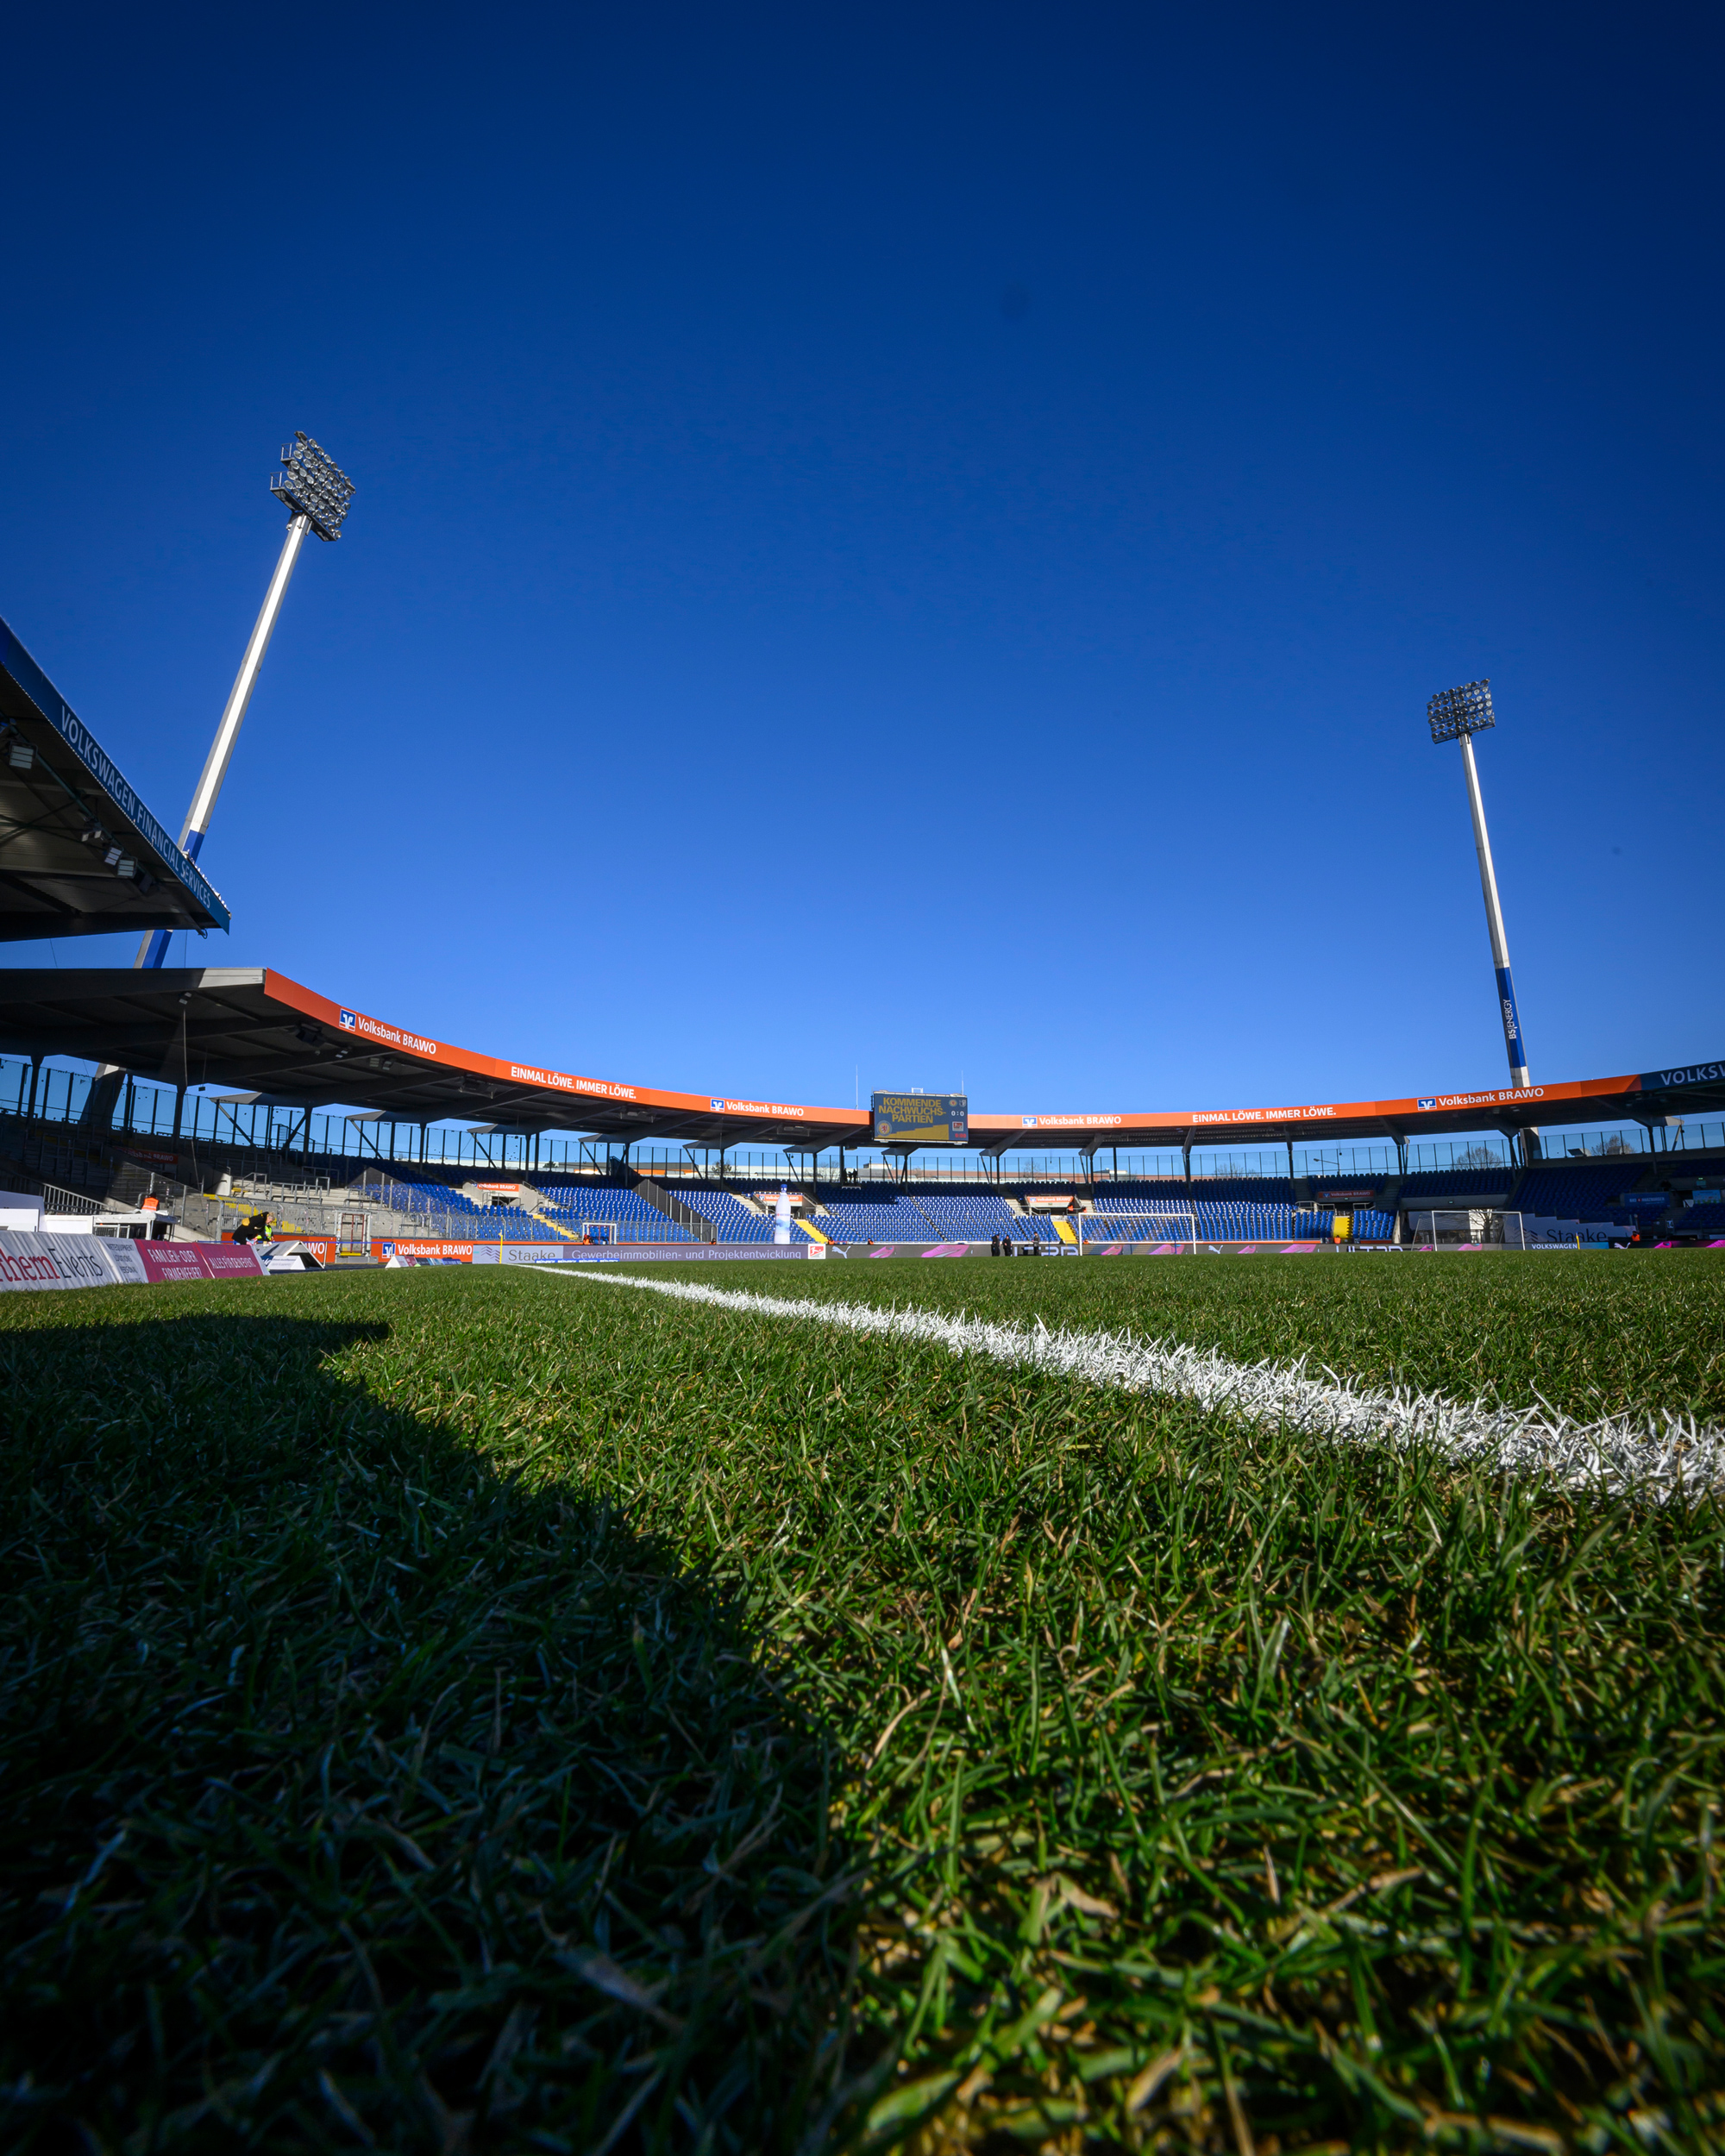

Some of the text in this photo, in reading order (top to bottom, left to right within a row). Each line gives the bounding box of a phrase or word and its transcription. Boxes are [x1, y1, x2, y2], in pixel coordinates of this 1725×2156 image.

[62, 705, 210, 909] VOLKSWAGEN FINANCIAL SERVICES
[358, 1017, 436, 1055] Volksbank BRAWO
[511, 1066, 637, 1099] EINMAL LÖWE. IMMER LÖWE.
[883, 1097, 941, 1107] KOMMENDE
[1439, 1087, 1544, 1106] Volksbank BRAWO
[726, 1101, 804, 1116] Volksbank BRAWO
[878, 1106, 946, 1116] NACHWUCHS-
[1192, 1106, 1336, 1123] EINMAL LÖWE. IMMER LÖWE.
[892, 1114, 933, 1124] PARTIEN
[1087, 1116, 1121, 1125] BRAWO
[179, 1250, 199, 1263] ODER
[398, 1244, 473, 1256] Volksbank BRAWO
[508, 1249, 555, 1262] Staake
[572, 1249, 681, 1260] Gewerbeimmobilien-
[686, 1250, 705, 1260] und
[708, 1250, 801, 1260] Projektentwicklung
[0, 1247, 104, 1282] thern Events
